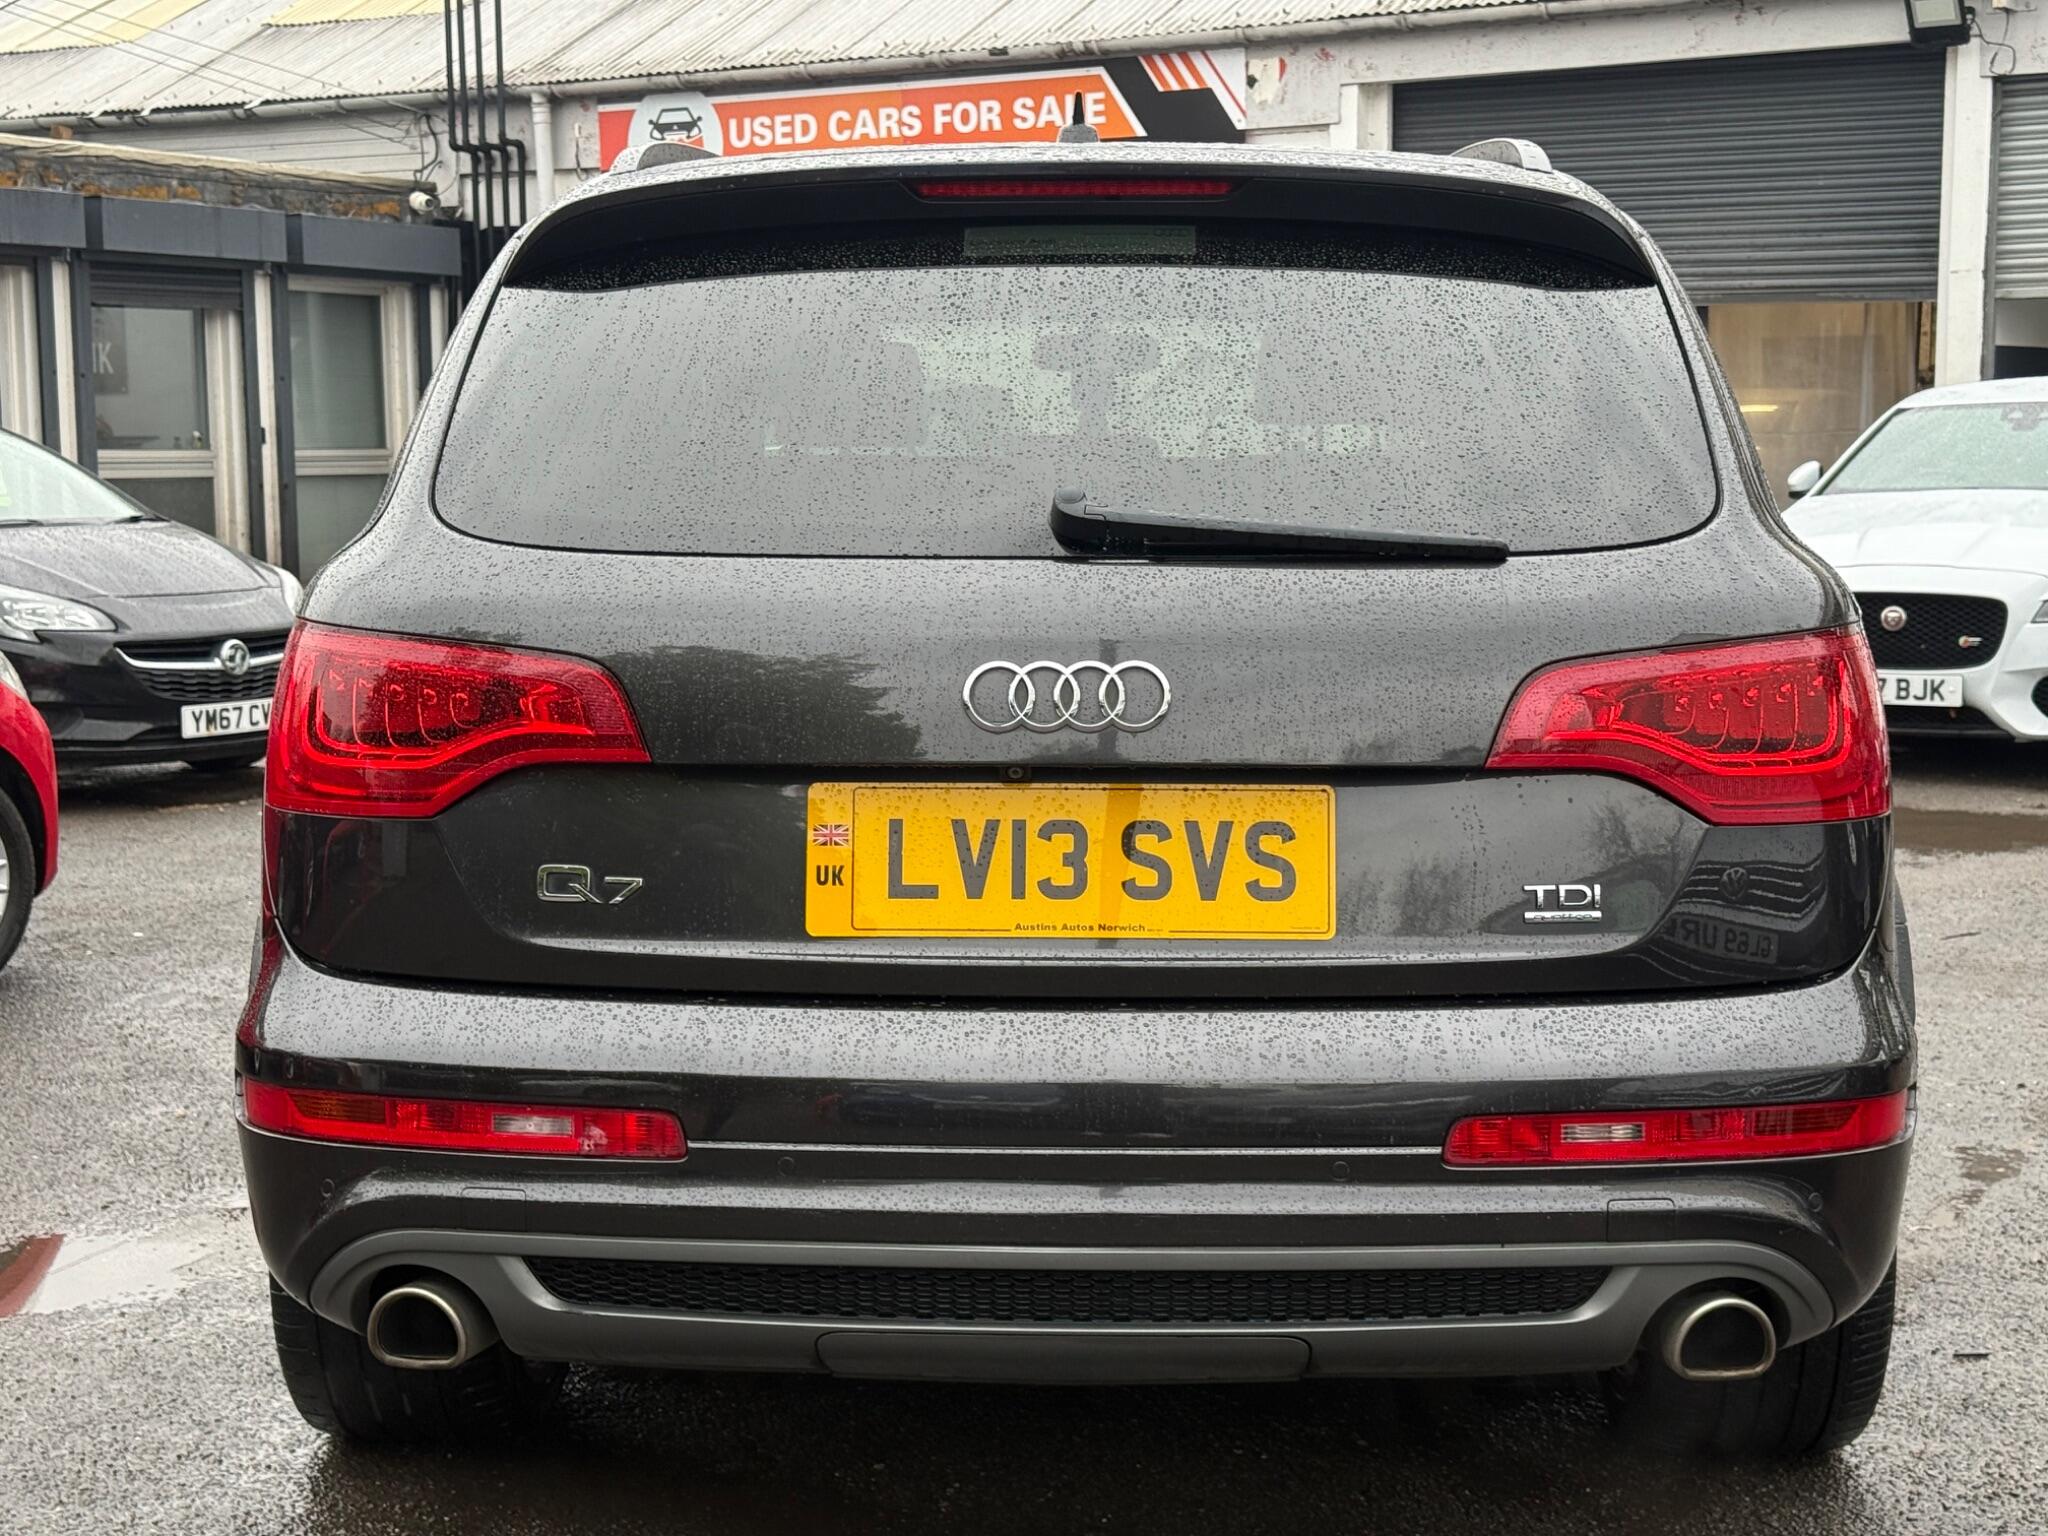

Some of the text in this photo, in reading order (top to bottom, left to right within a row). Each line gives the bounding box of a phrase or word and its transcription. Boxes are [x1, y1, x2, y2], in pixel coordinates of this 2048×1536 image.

[728, 112, 818, 149] USED
[827, 104, 921, 142] CARS
[933, 98, 1002, 135] FOR
[1895, 678, 1945, 701] BJK
[191, 706, 243, 733] YM67
[887, 818, 1297, 902] LV13 SVS
[537, 863, 643, 904] Q7
[815, 864, 845, 887] UK
[1523, 883, 1601, 909] TDI
[1014, 922, 1057, 932] Austins
[1061, 923, 1094, 932] Autos
[1098, 923, 1146, 932] Norwich
